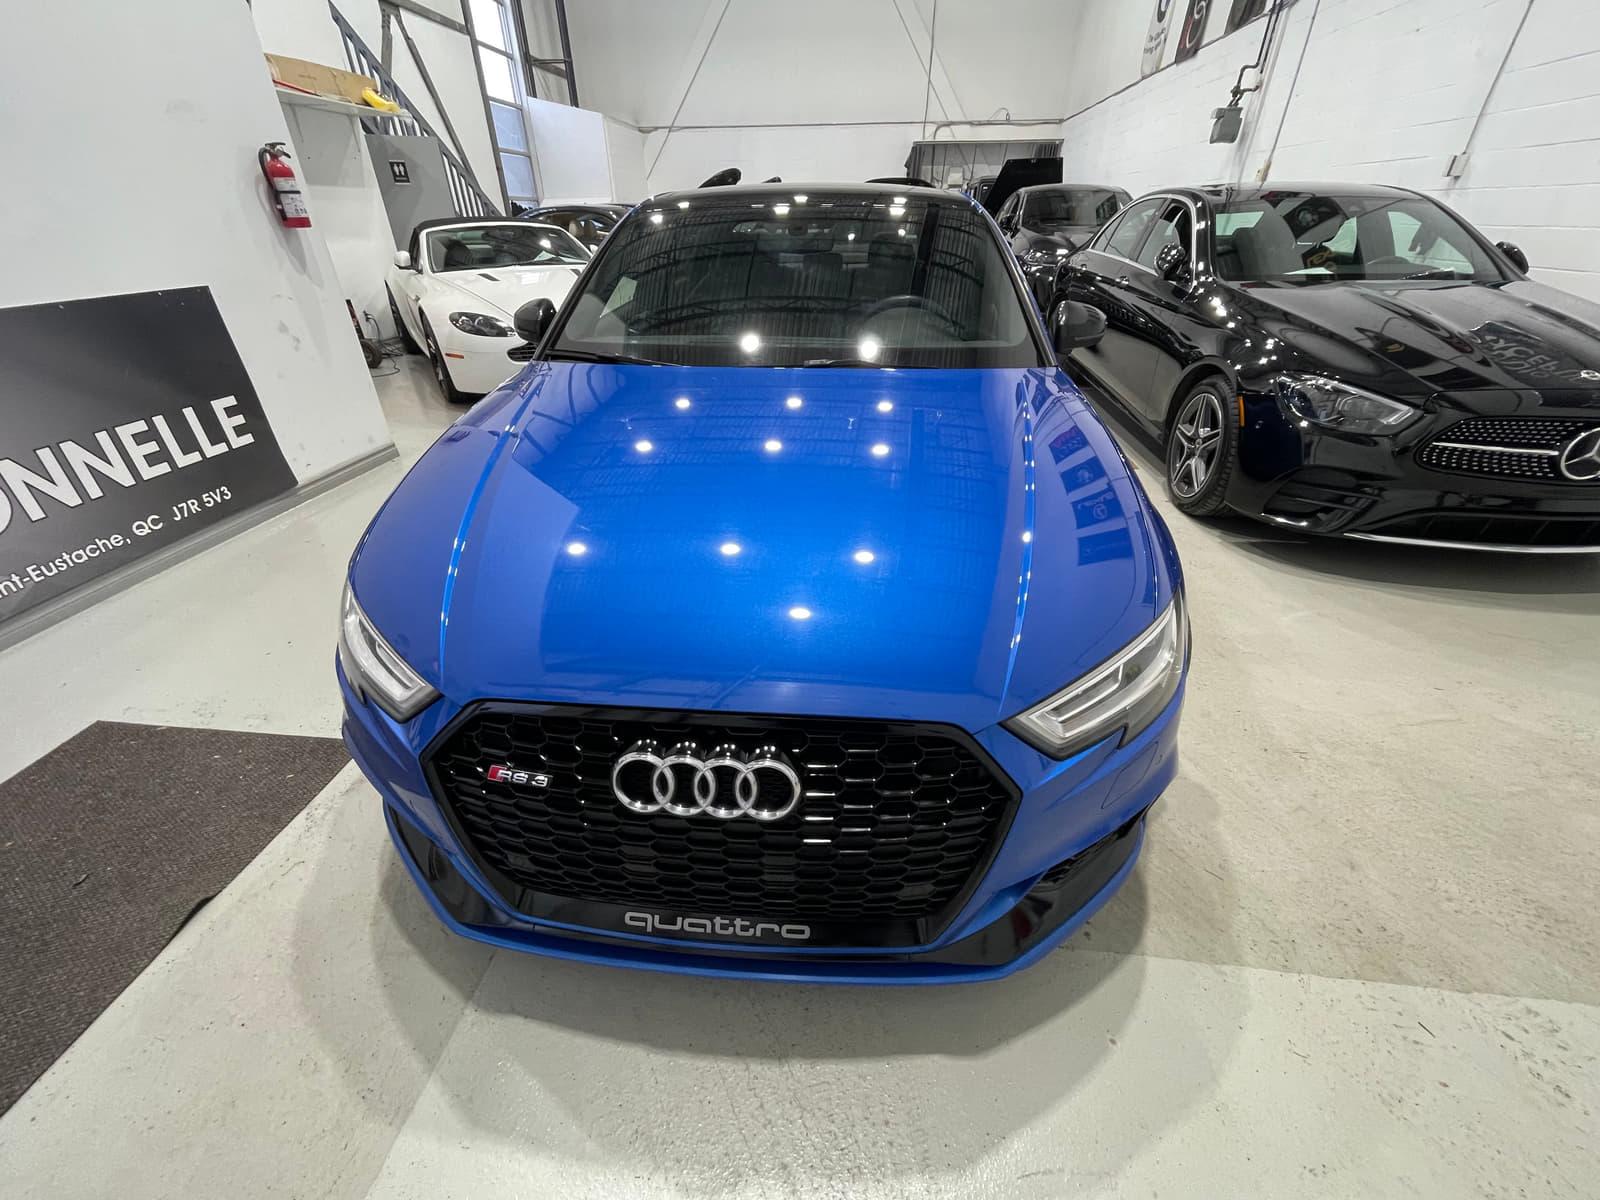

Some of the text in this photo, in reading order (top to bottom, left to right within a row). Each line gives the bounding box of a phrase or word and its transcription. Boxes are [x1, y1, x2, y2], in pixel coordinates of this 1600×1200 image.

[0, 395, 255, 533] NNELLE
[0, 486, 232, 599] nt-Eustache, QC J7R 5V3
[624, 911, 811, 940] quattro
